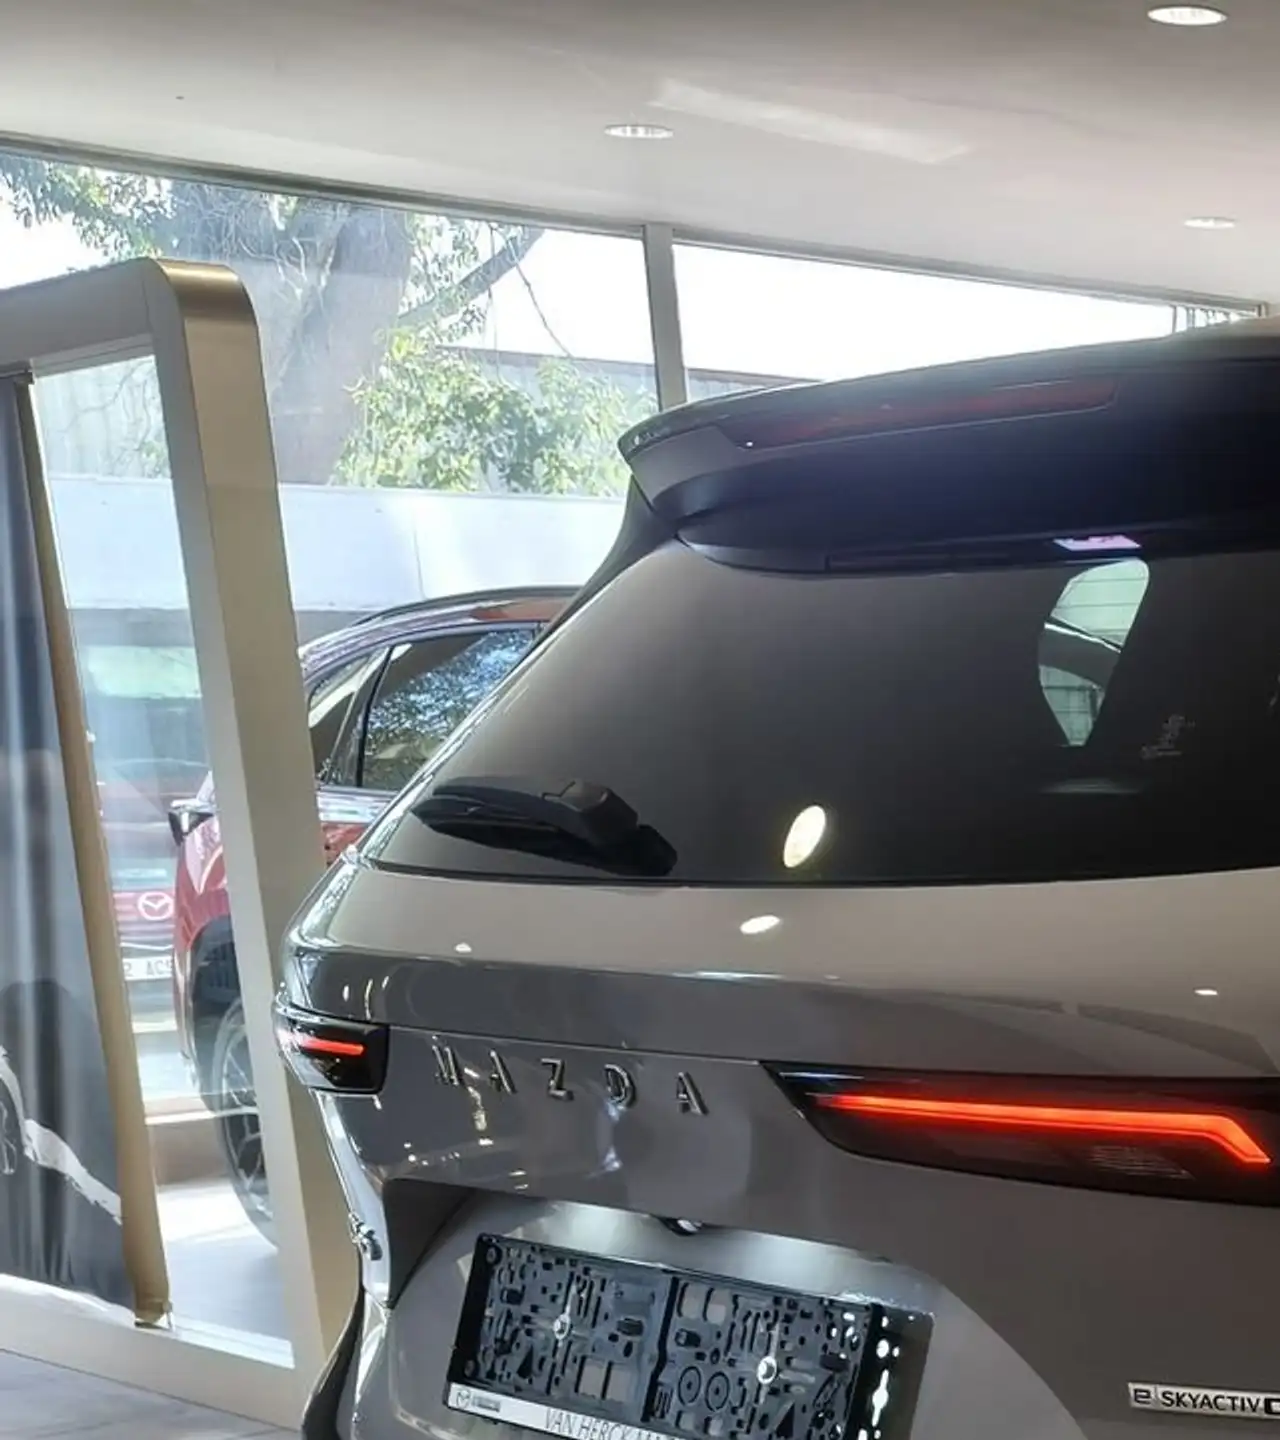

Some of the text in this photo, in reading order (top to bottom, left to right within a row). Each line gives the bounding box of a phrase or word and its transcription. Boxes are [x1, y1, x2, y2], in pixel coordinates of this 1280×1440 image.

[432, 1043, 709, 1116] MAZDA
[1161, 1390, 1261, 1413] SKYACTIV
[545, 1408, 574, 1433] VAN
